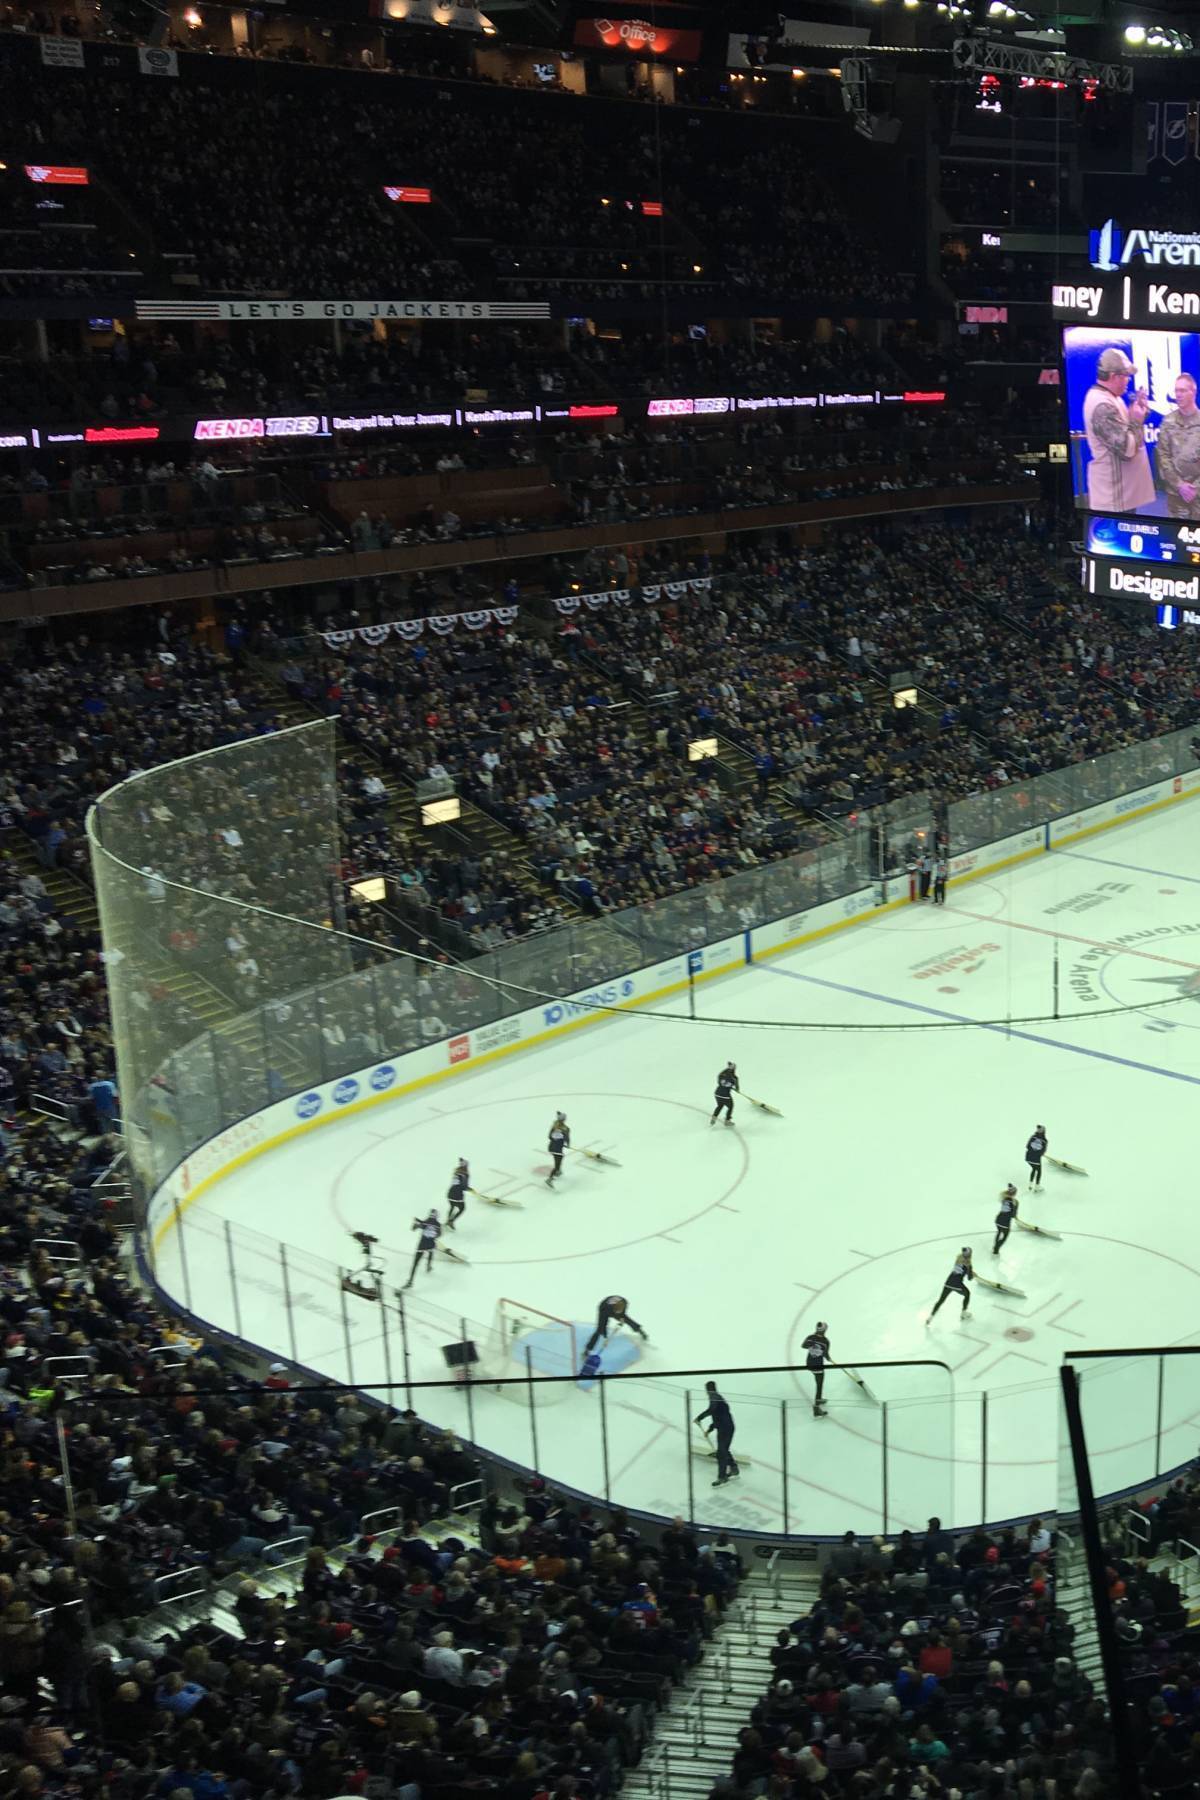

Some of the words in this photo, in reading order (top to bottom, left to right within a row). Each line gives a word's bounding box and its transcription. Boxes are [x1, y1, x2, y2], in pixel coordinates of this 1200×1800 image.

[620, 24, 656, 42] Office
[230, 303, 305, 318] LET'S
[324, 303, 355, 317] GO
[369, 303, 484, 318] JACKETS
[648, 399, 693, 416] KENDA
[693, 397, 729, 413] TIRES
[333, 415, 377, 431] Designed
[377, 414, 393, 427] for
[393, 414, 416, 426] Your
[416, 412, 452, 426] Journey
[465, 410, 534, 423] KendaTire.com
[194, 418, 264, 441] KENDA
[265, 416, 319, 437] TIRES
[1118, 522, 1159, 536] COLUMBUS
[1130, 535, 1143, 553] 0
[1192, 553, 1200, 563] 2
[1110, 568, 1199, 601] Designed
[1069, 964, 1099, 1002] Arena
[544, 1004, 563, 1026] 10
